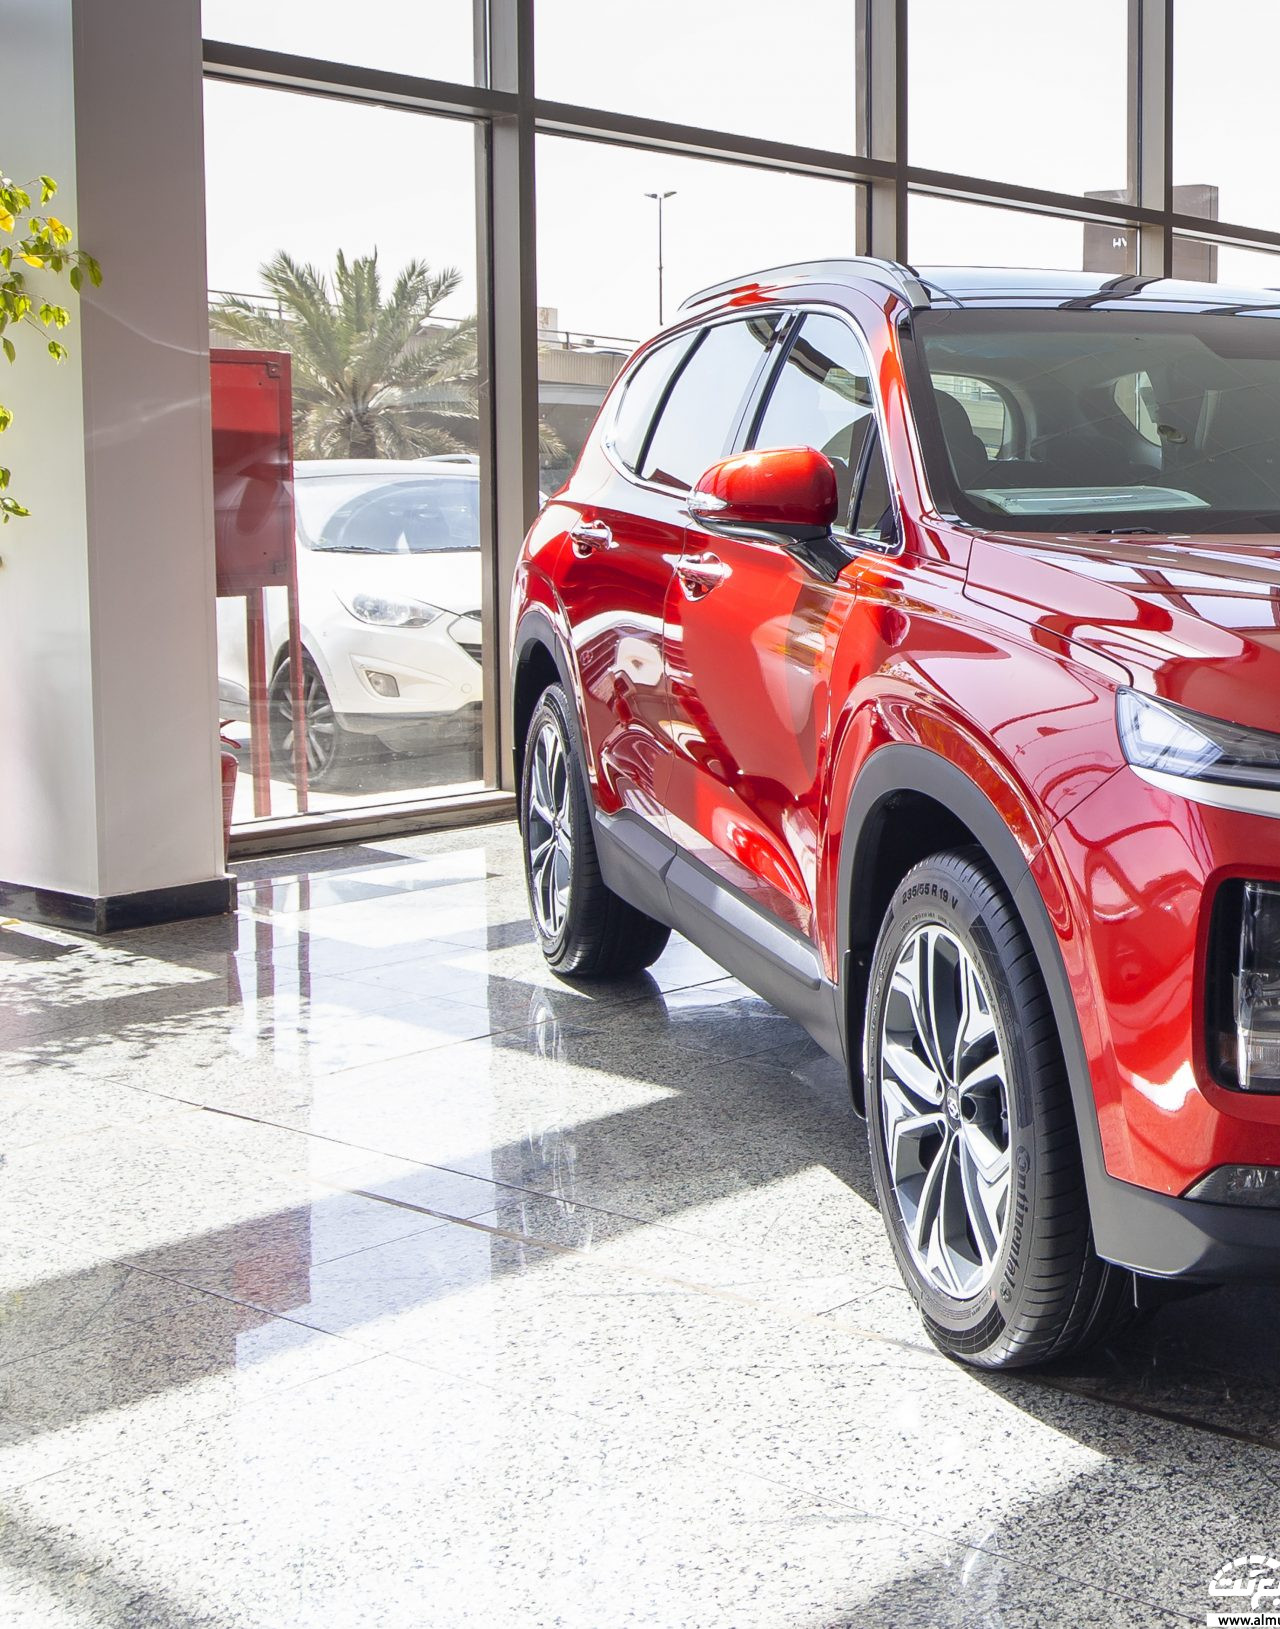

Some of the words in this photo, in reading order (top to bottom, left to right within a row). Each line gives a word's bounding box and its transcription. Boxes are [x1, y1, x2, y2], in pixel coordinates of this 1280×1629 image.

[902, 882, 931, 905] 235/55
[931, 883, 938, 897] R
[939, 887, 949, 903] 19
[951, 895, 959, 910] V
[1003, 1145, 1031, 1289] Continental
